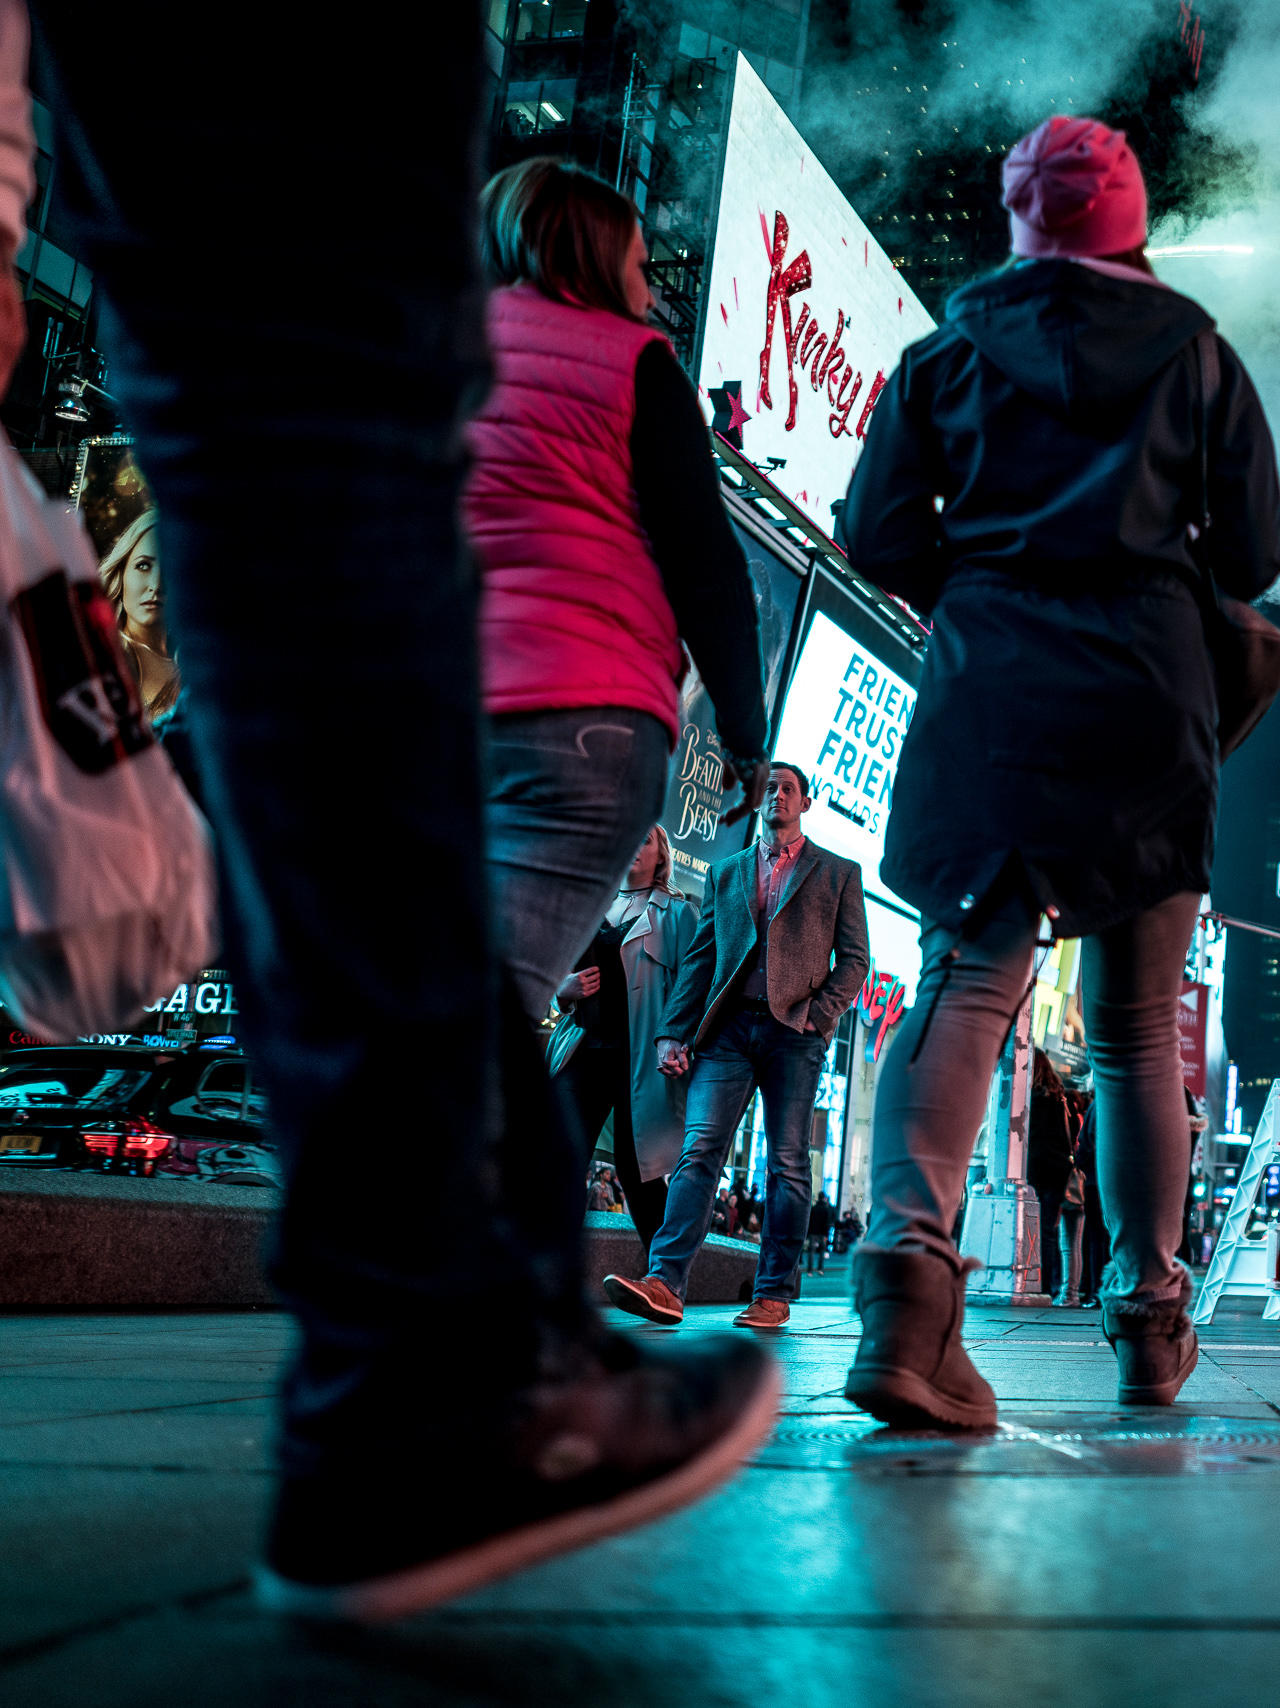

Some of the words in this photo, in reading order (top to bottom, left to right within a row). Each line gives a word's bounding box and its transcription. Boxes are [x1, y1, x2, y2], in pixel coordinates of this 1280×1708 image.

[757, 210, 854, 439] Kinky
[833, 687, 906, 760] TRUS
[673, 782, 720, 842] BEAST
